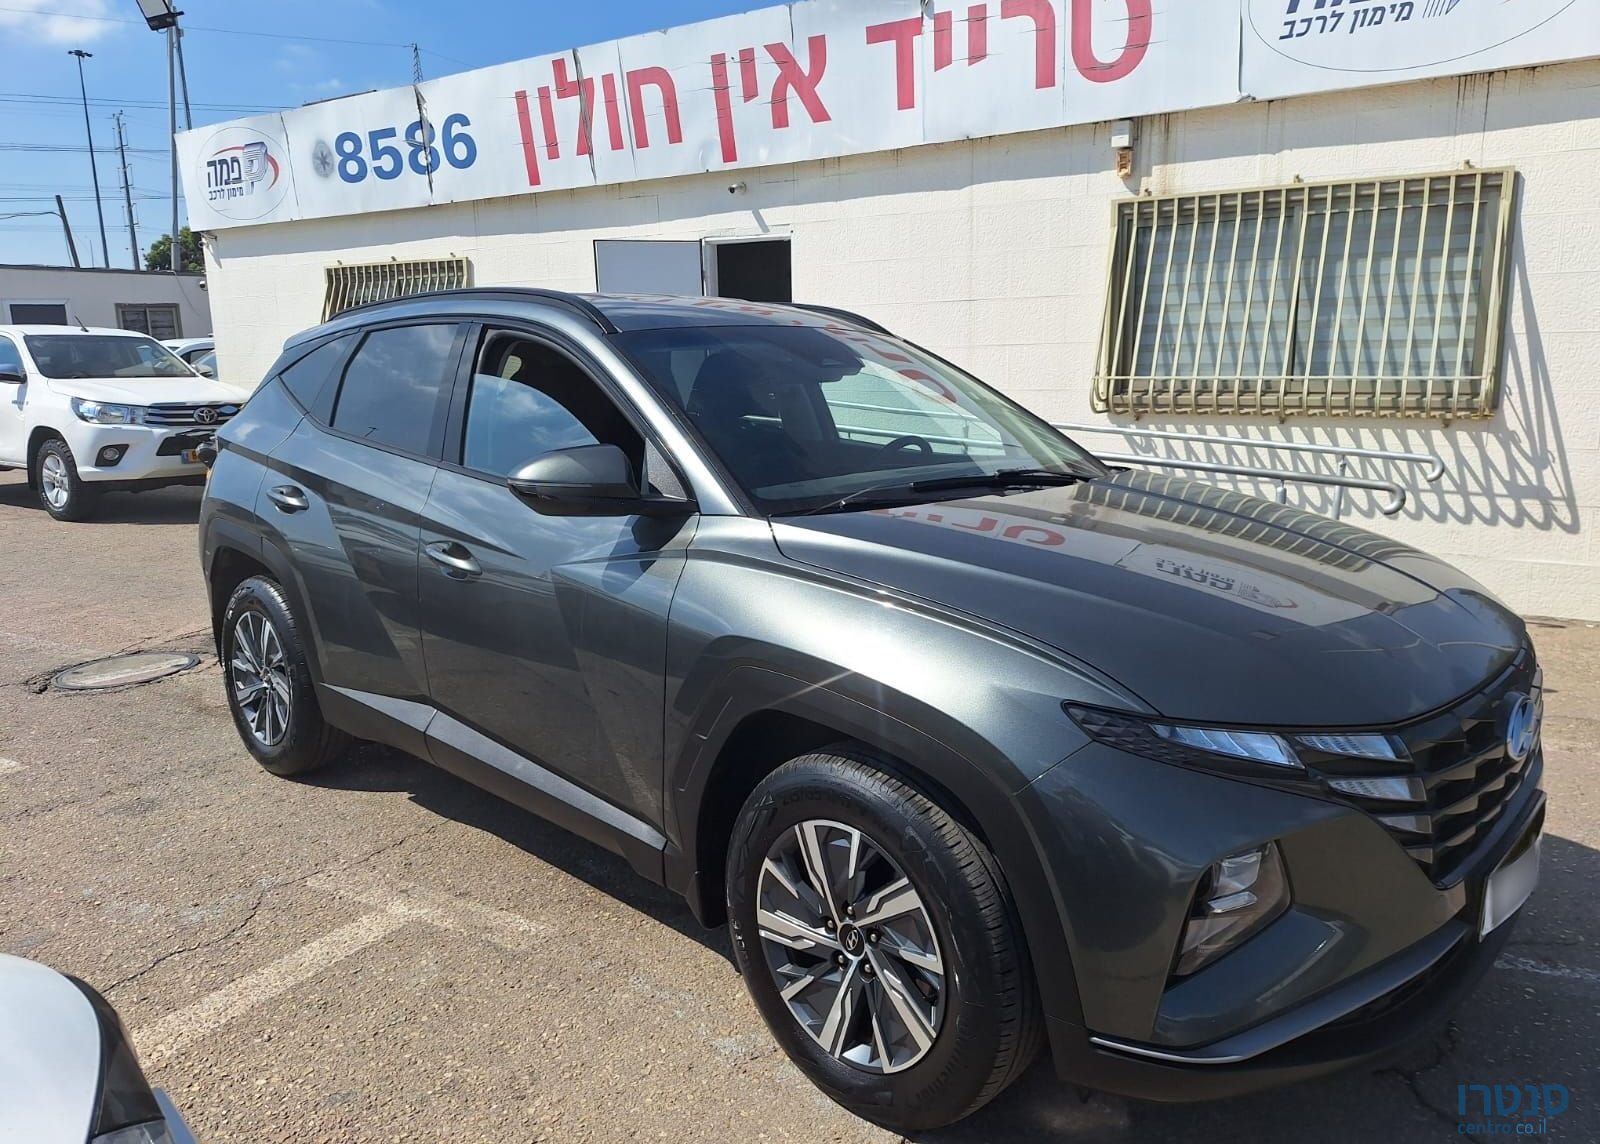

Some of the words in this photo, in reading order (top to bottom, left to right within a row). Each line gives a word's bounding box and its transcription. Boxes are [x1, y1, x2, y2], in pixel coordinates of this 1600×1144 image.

[866, 0, 1152, 111] טרייד
[1279, 10, 1344, 40] לרכב
[1349, 1, 1414, 34] מימון
[515, 58, 683, 186] חולון
[711, 34, 832, 163] אין
